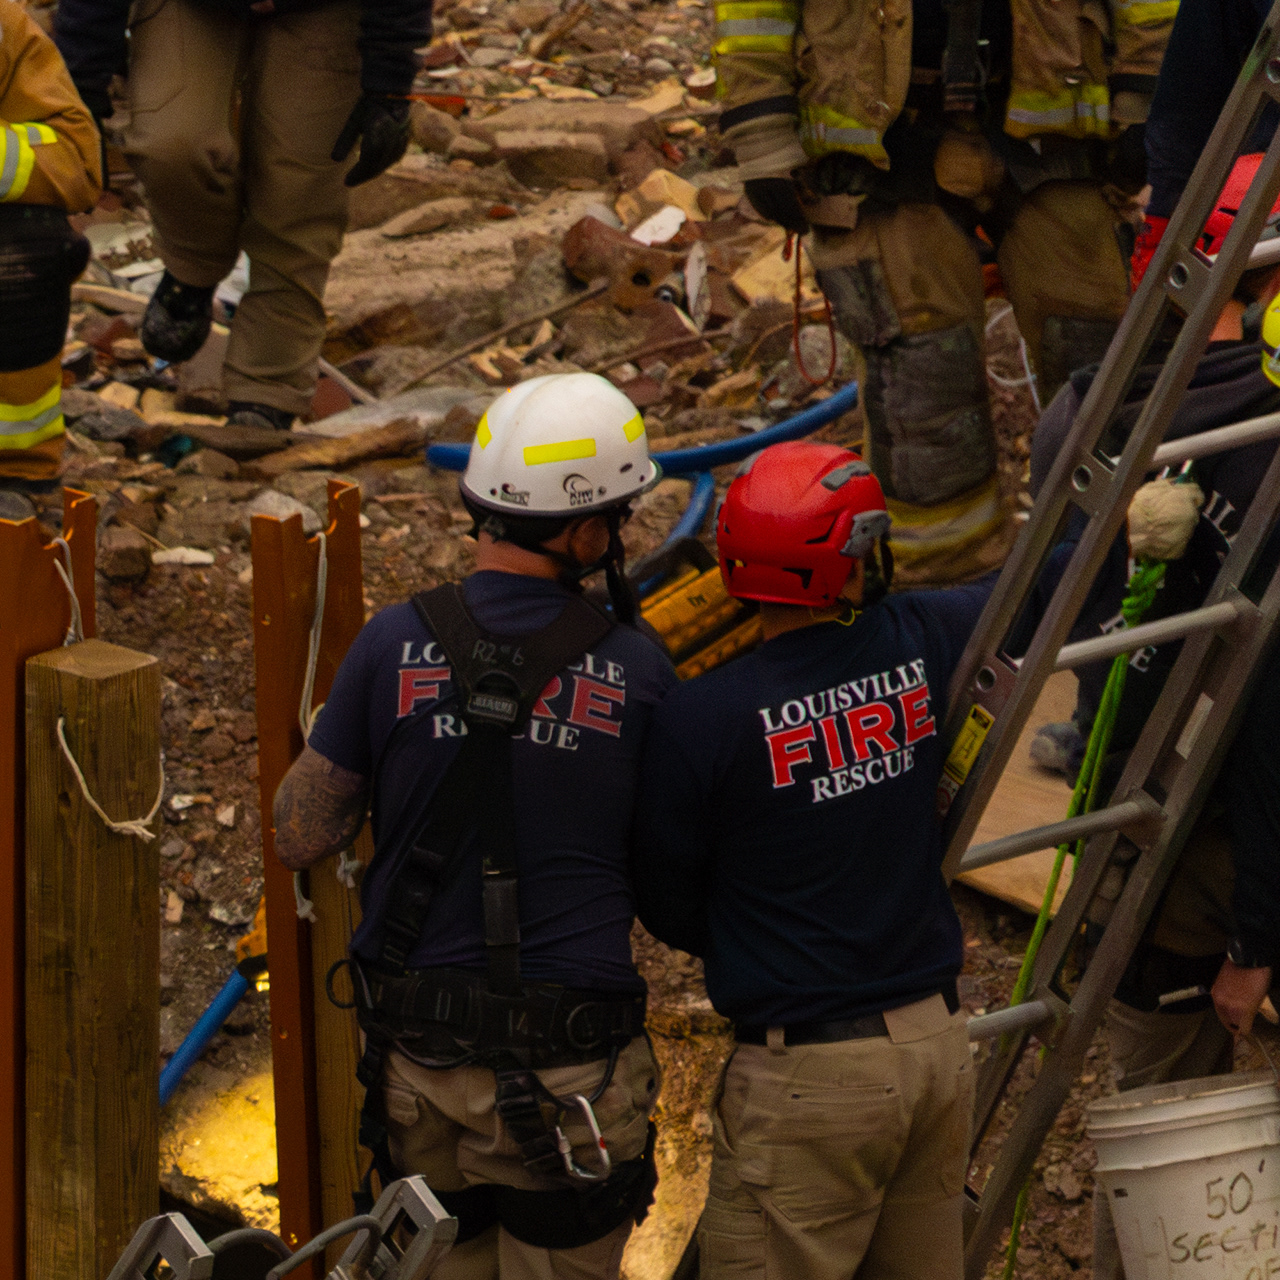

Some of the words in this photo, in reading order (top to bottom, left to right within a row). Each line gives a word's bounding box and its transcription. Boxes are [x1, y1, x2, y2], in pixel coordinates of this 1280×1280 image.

[396, 667, 626, 738] FRE
[758, 657, 928, 734] LOUISVILLE
[765, 683, 938, 789] FIRE
[810, 746, 915, 804] RESCUE
